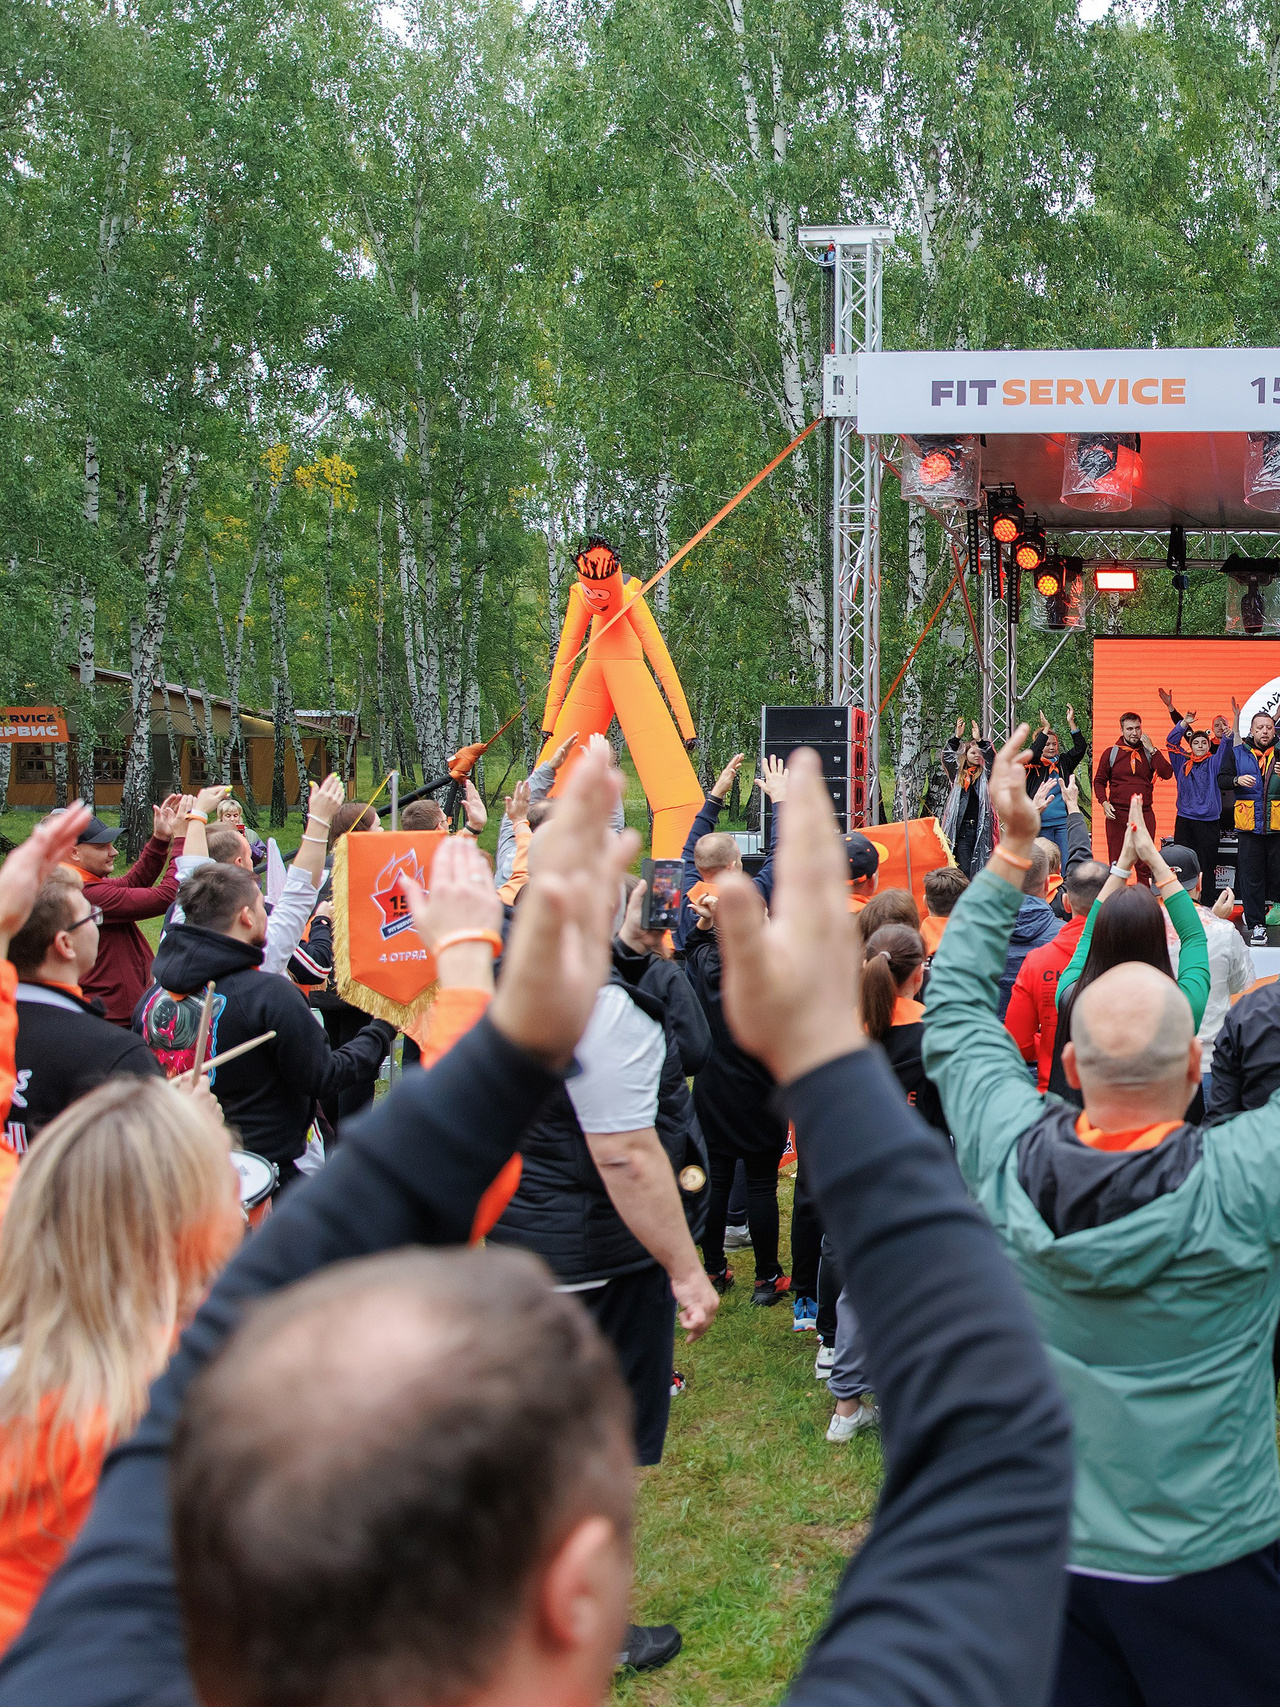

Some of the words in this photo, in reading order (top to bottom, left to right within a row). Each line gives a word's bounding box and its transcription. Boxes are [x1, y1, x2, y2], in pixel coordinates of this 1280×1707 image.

[0, 715, 56, 723] RVICE
[379, 953, 388, 963] 4
[389, 949, 427, 962] ОТРЯД
